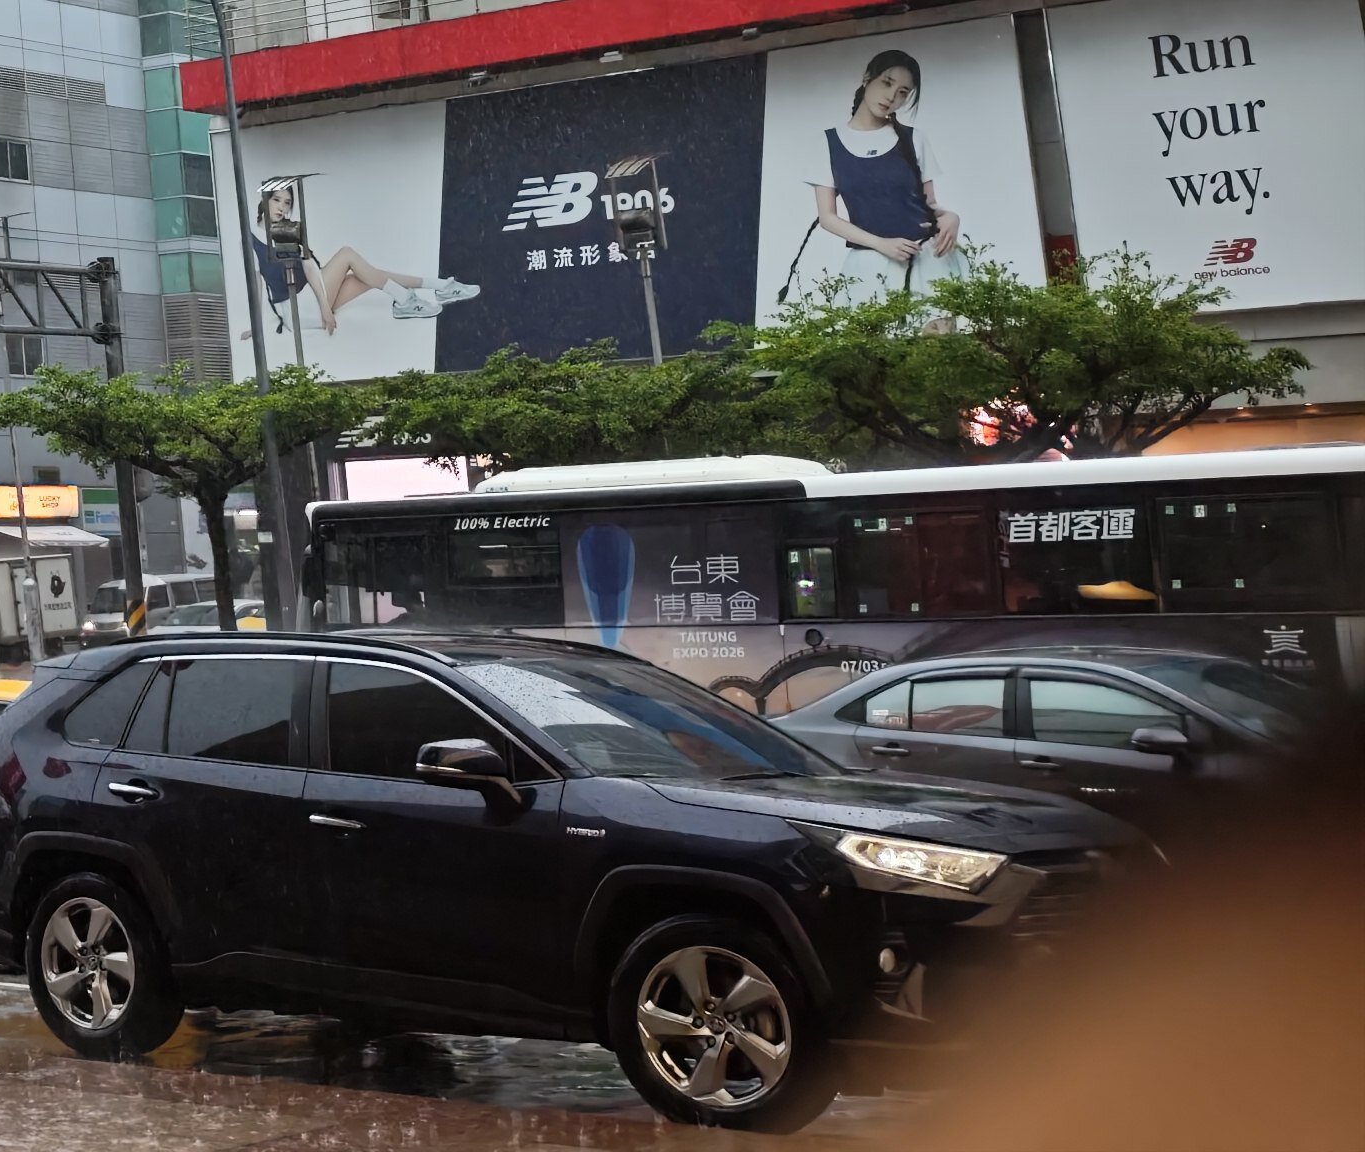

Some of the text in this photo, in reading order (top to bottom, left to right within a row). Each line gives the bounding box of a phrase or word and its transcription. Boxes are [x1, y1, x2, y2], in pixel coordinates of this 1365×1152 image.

[1148, 34, 1257, 79] Run
[1152, 99, 1266, 157] your
[1166, 167, 1270, 215] way.
[1194, 265, 1271, 280] new balance
[454, 515, 551, 530] 100% Electric
[1007, 508, 1136, 543] 首都客運
[670, 553, 739, 585] 台東
[654, 590, 760, 623] 博覽會
[672, 647, 745, 658] EXPO 2026
[679, 631, 737, 643] TAITUNG
